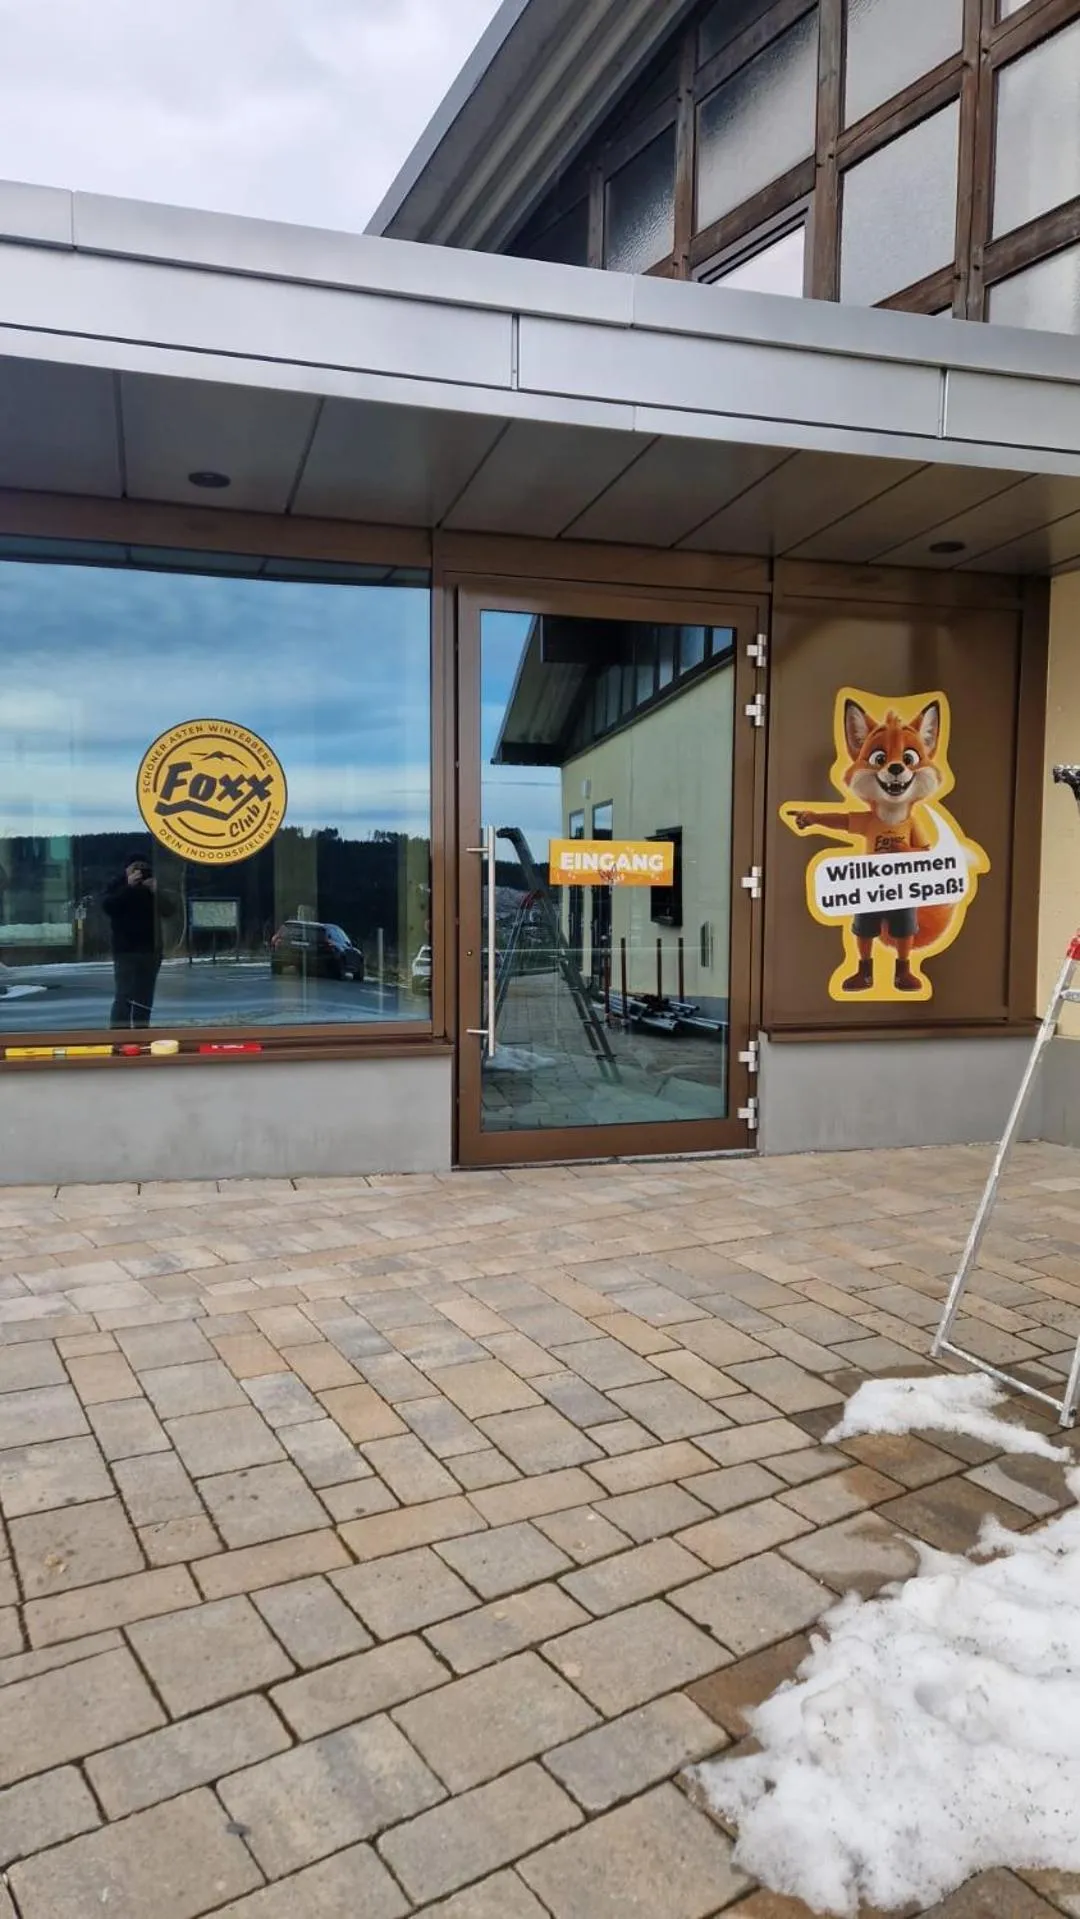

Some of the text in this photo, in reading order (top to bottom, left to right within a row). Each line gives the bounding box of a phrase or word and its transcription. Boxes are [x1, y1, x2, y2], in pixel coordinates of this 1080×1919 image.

[169, 725, 204, 744] ASTEN
[208, 725, 274, 768] WINTERBERG
[158, 809, 280, 860] DEIN INDOORSPIELPLATZ
[229, 804, 261, 838] Club
[560, 851, 664, 872] EINGANG
[826, 856, 957, 882] Willkommen
[821, 877, 965, 908] und viel Spaß!
